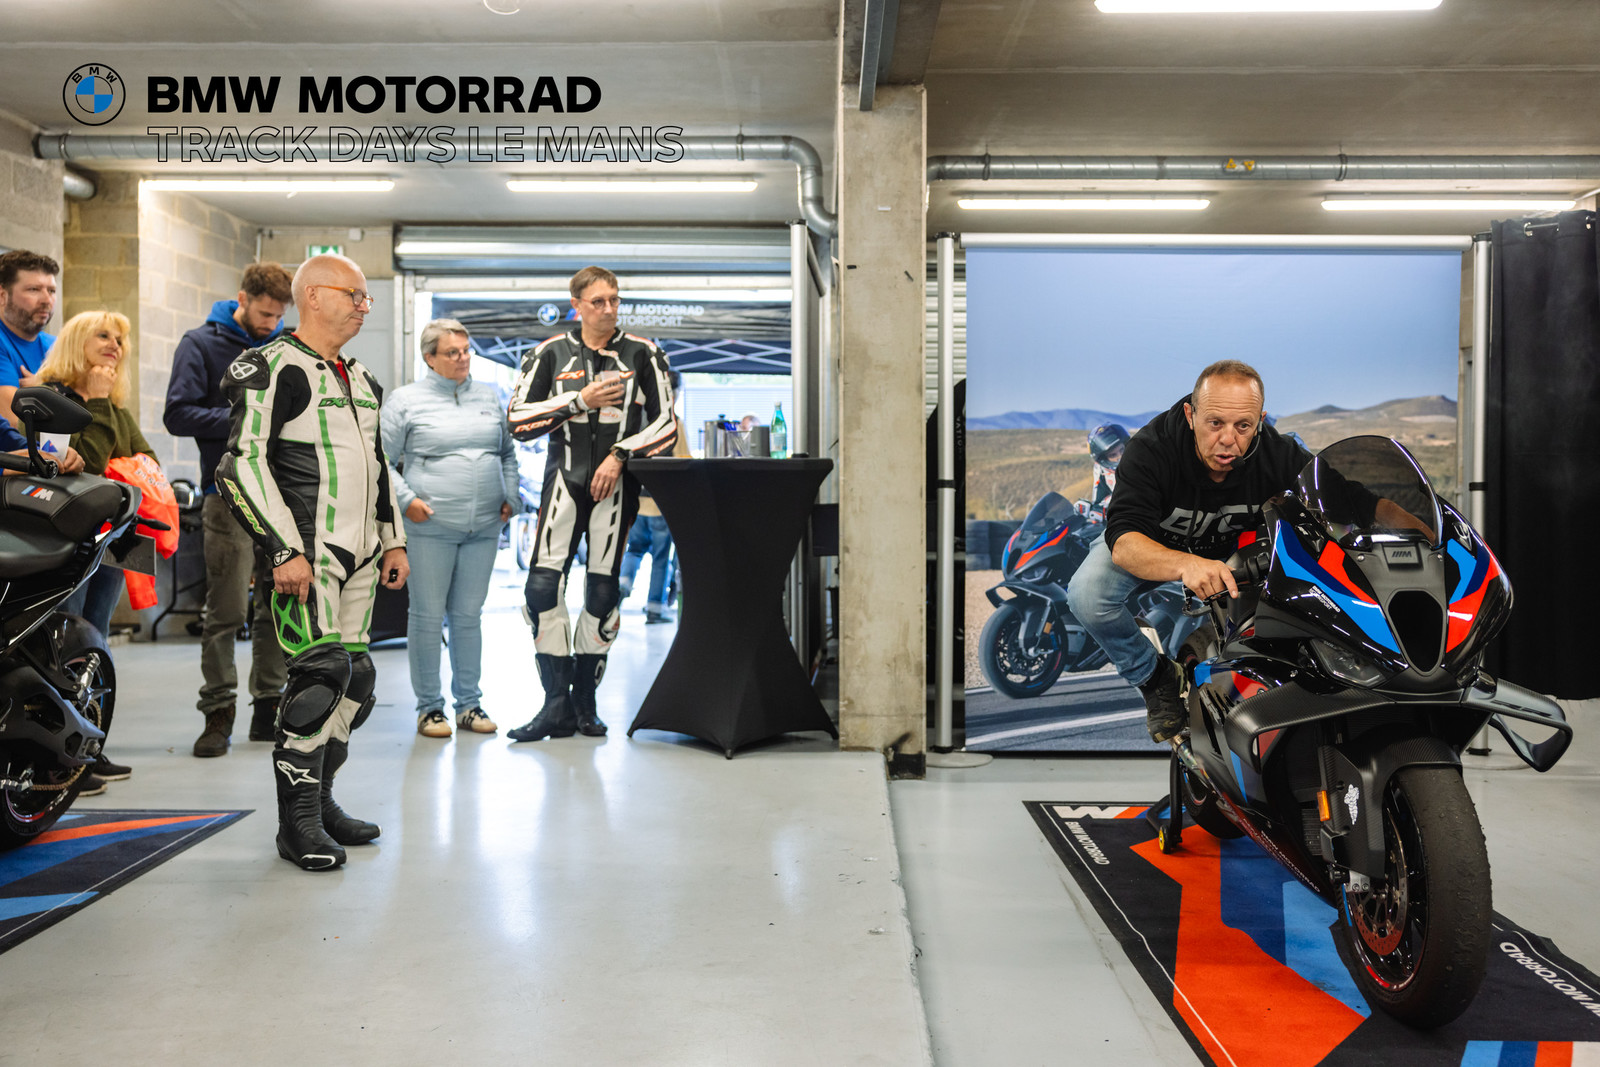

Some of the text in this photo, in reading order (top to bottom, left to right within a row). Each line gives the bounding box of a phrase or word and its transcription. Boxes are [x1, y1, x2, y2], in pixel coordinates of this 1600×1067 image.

[635, 304, 704, 316] MOTORRAD
[615, 314, 683, 327] OTORSPORT
[1499, 941, 1594, 1001] MOTORRAD
